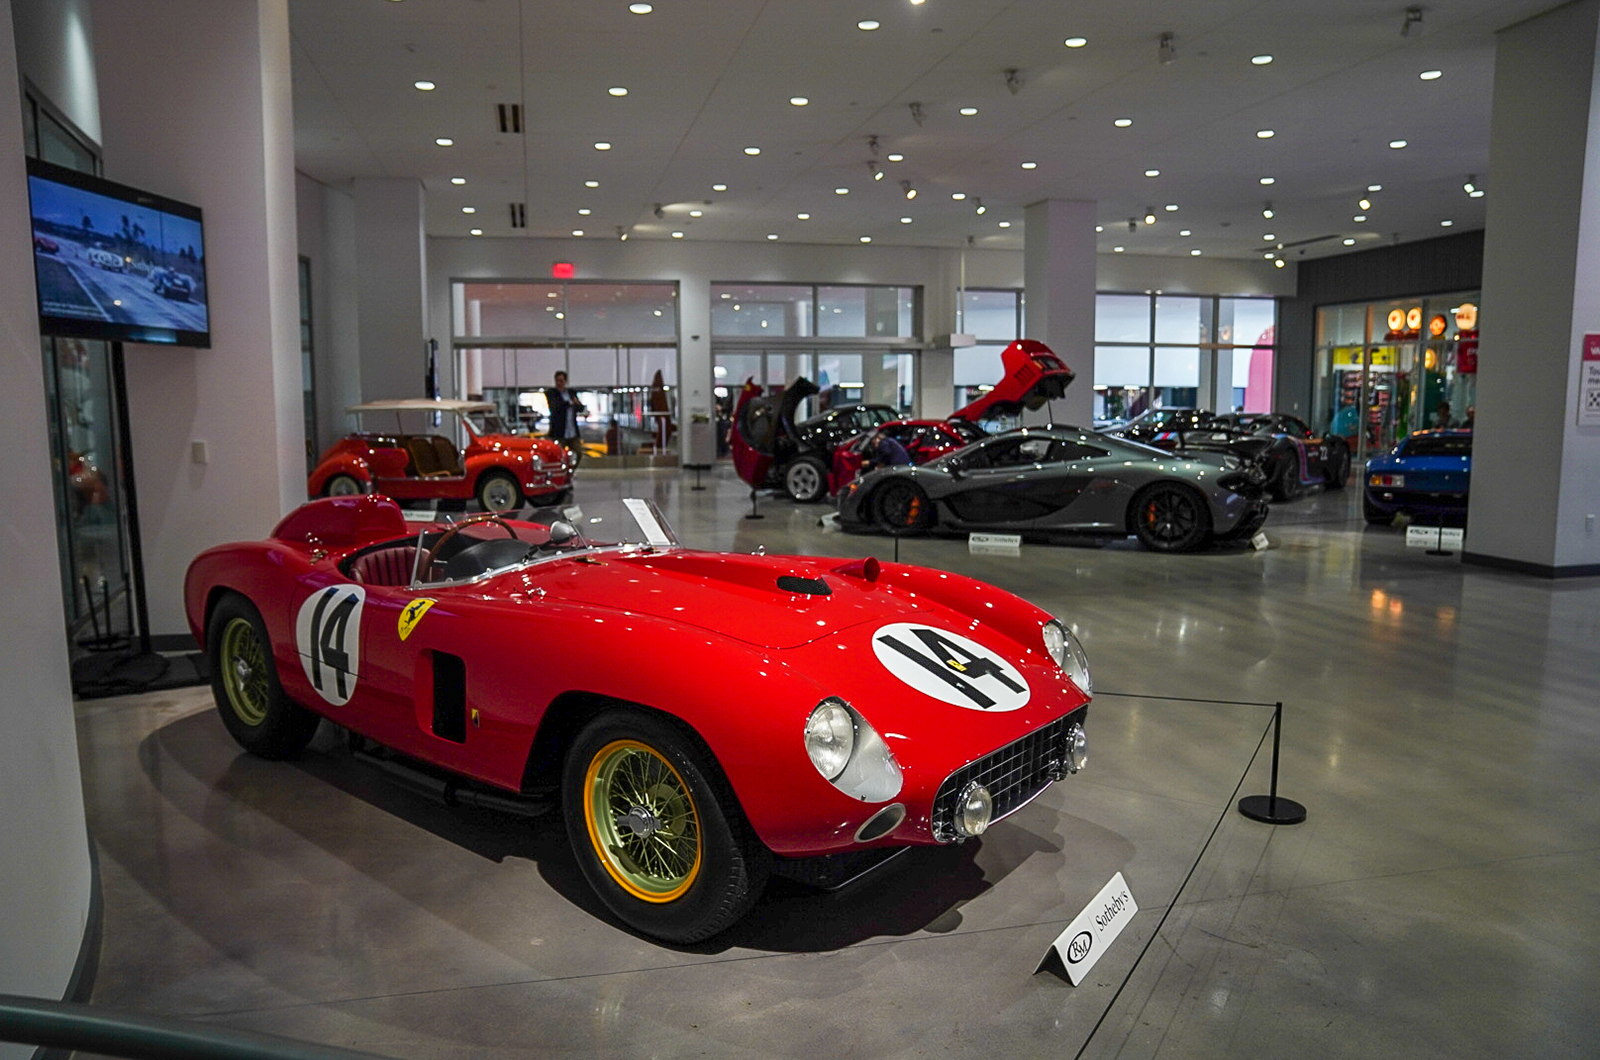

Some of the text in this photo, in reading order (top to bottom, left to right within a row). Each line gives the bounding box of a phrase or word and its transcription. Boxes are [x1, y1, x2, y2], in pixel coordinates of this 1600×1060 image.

[309, 587, 360, 700] 14
[876, 628, 1028, 709] 14
[1070, 890, 1130, 958] RM Sotheby's
